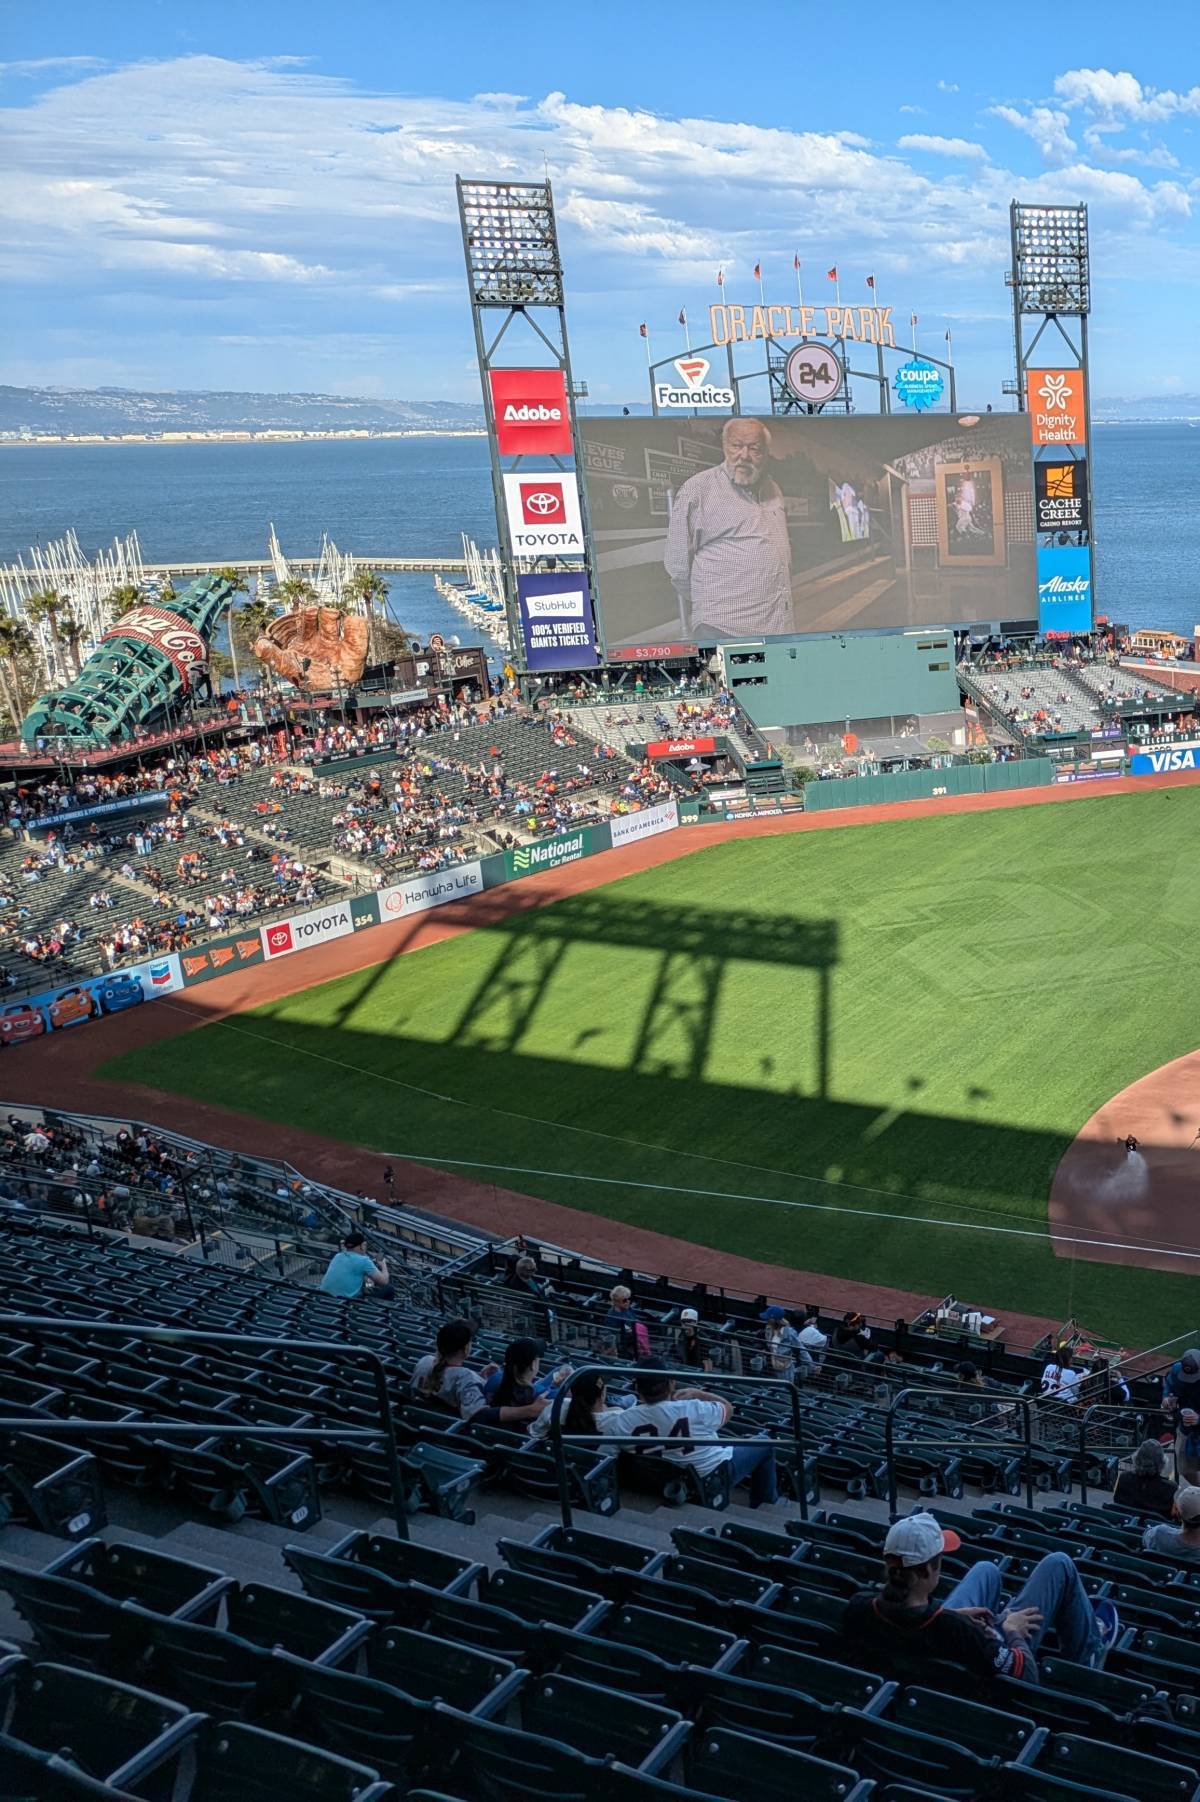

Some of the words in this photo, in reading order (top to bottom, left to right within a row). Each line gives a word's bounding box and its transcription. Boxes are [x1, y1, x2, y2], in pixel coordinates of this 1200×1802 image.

[709, 304, 816, 346] ORACLE
[824, 306, 896, 347] PARK
[798, 362, 835, 388] 24
[900, 370, 939, 384] coupa
[659, 387, 731, 405] Fanatics
[504, 404, 562, 421] Adobe
[1036, 414, 1076, 429] Dignity
[1039, 429, 1076, 441] Health
[1039, 498, 1082, 509] CACHE
[1041, 509, 1080, 520] CREEK
[515, 533, 579, 547] TOYOTA
[1039, 575, 1090, 594] Alaska
[1041, 594, 1086, 603] AIRLINES
[534, 600, 577, 612] StubHub
[531, 624, 552, 636] 100%
[553, 622, 586, 635] VERIFIED
[531, 635, 558, 648] GIANTS
[559, 634, 589, 646] TICKETS
[635, 647, 671, 658] $3,790
[455, 655, 474, 668] Coffee
[1141, 735, 1175, 745] WELCOME
[1180, 733, 1188, 741] TO
[669, 743, 695, 752] Adobe
[1147, 750, 1195, 772] VISA
[932, 786, 947, 796] 391
[681, 815, 698, 824] 399
[734, 811, 757, 820] KONICA
[757, 808, 783, 817] MINOLTA
[613, 828, 630, 839] BANK
[630, 825, 639, 833] OF
[638, 817, 664, 832] AMERICA
[531, 833, 584, 864] National
[550, 858, 561, 868] Car
[561, 851, 582, 864] Rental
[405, 882, 454, 905] Hanwha
[455, 874, 477, 889] Life
[295, 912, 348, 939] TOYOTA
[354, 914, 373, 926] 354
